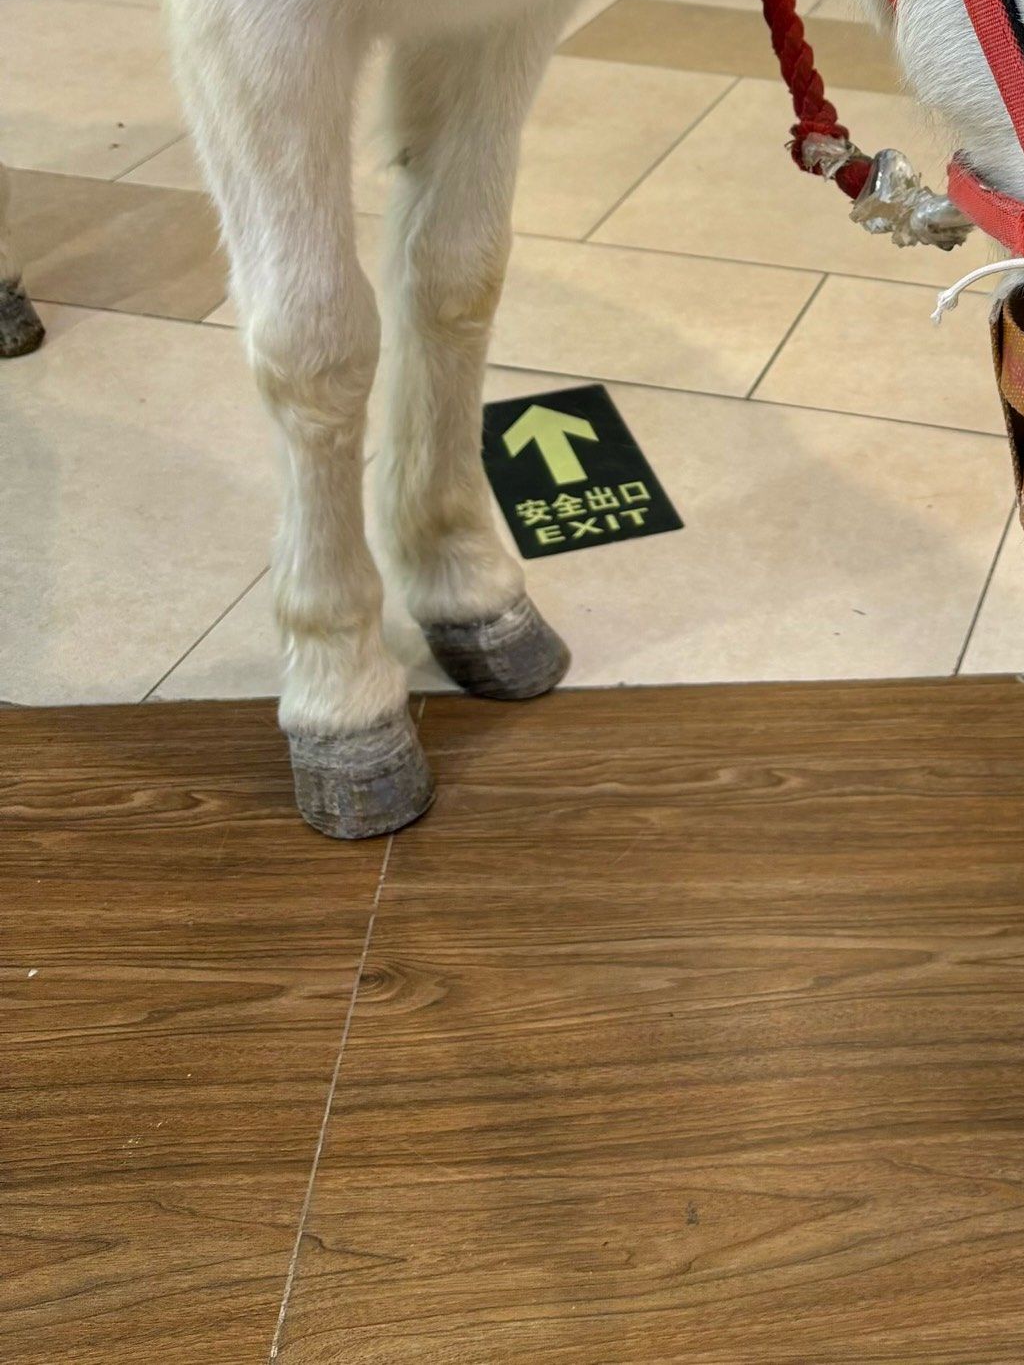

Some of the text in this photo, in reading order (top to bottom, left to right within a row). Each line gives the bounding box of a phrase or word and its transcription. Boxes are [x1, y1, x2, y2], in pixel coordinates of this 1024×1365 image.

[515, 481, 651, 526] 安全出口
[535, 507, 649, 545] EXIT
